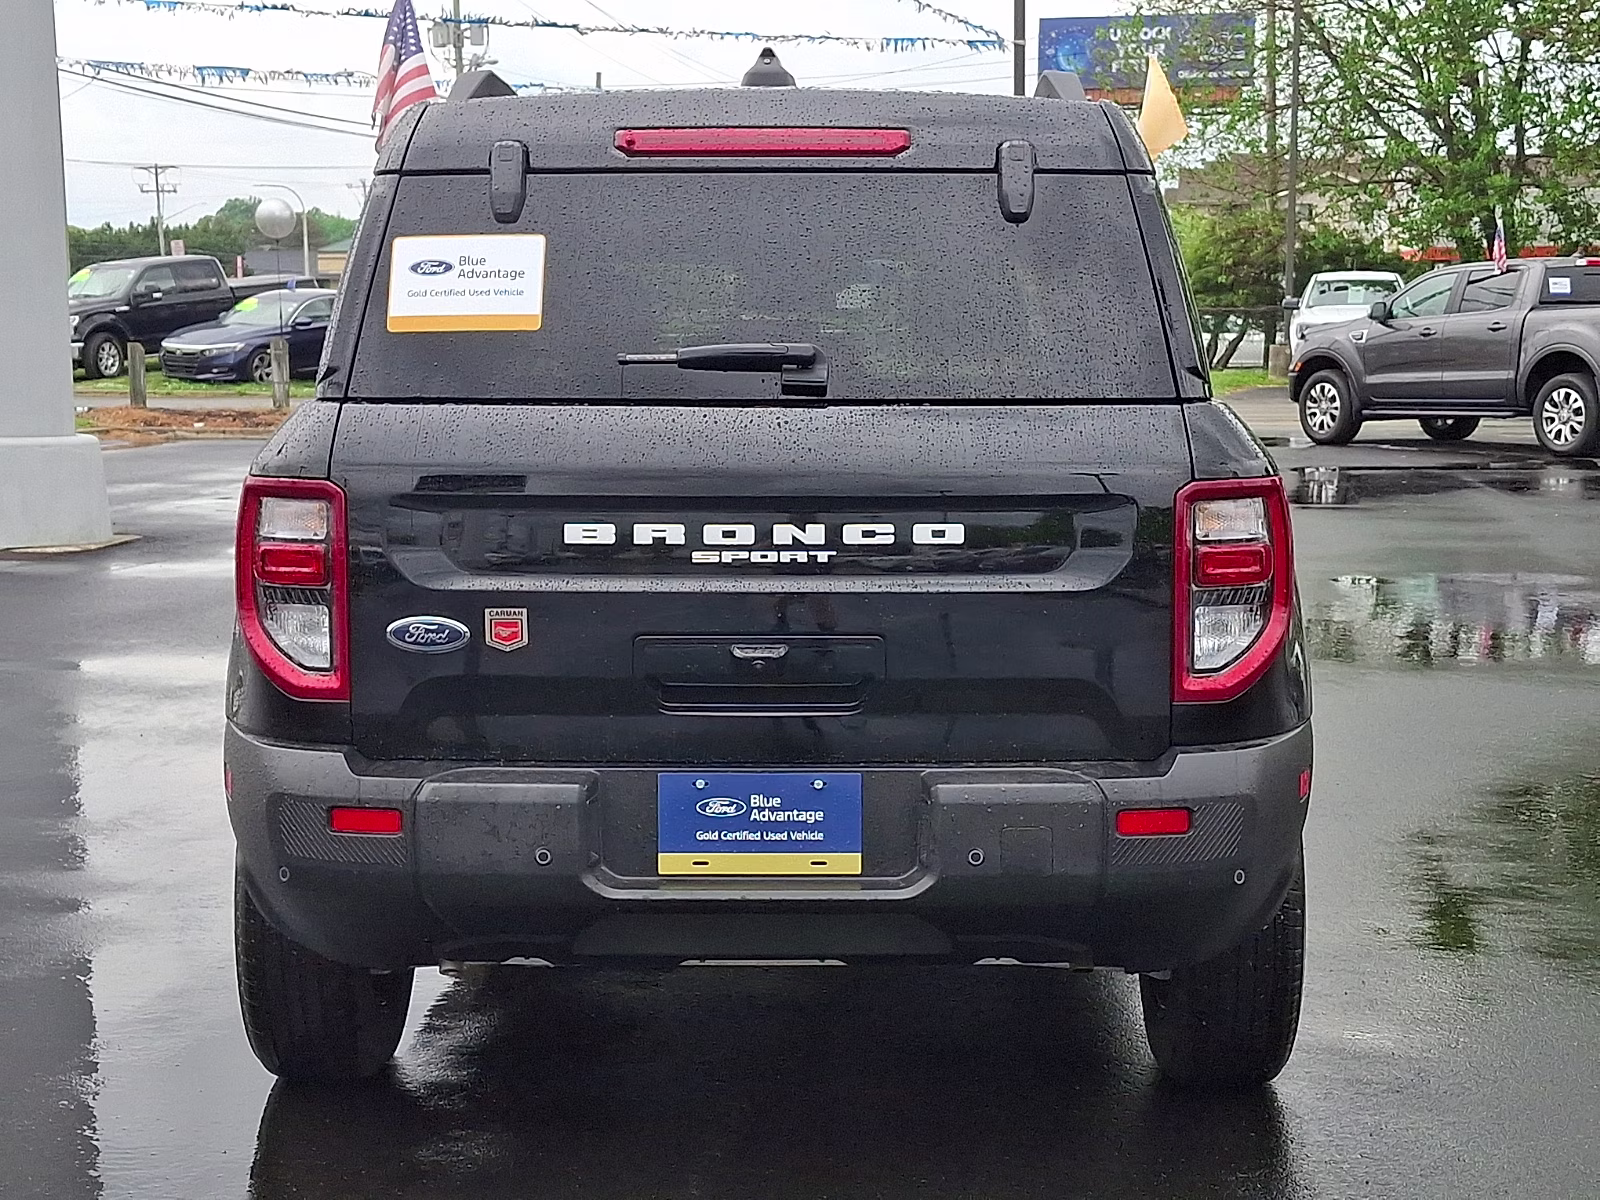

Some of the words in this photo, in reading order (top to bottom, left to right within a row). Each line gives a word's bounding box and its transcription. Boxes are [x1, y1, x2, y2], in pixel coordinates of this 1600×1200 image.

[458, 255, 487, 266] Blue
[417, 261, 446, 274] Ford
[457, 268, 525, 280] Advantage
[407, 289, 427, 297] Gold
[429, 288, 466, 297] Certified
[468, 287, 491, 296] Used
[493, 287, 525, 296] Vehicle
[562, 523, 965, 545] BRONCO
[691, 550, 837, 563] SPORT
[404, 623, 449, 644] Ford
[705, 801, 737, 814] Ford
[750, 794, 782, 808] Blue
[749, 808, 825, 824] Advantage
[695, 830, 719, 841] Gold
[720, 830, 761, 841] Certified
[763, 830, 788, 841] Used
[789, 830, 824, 841] Vehicle
